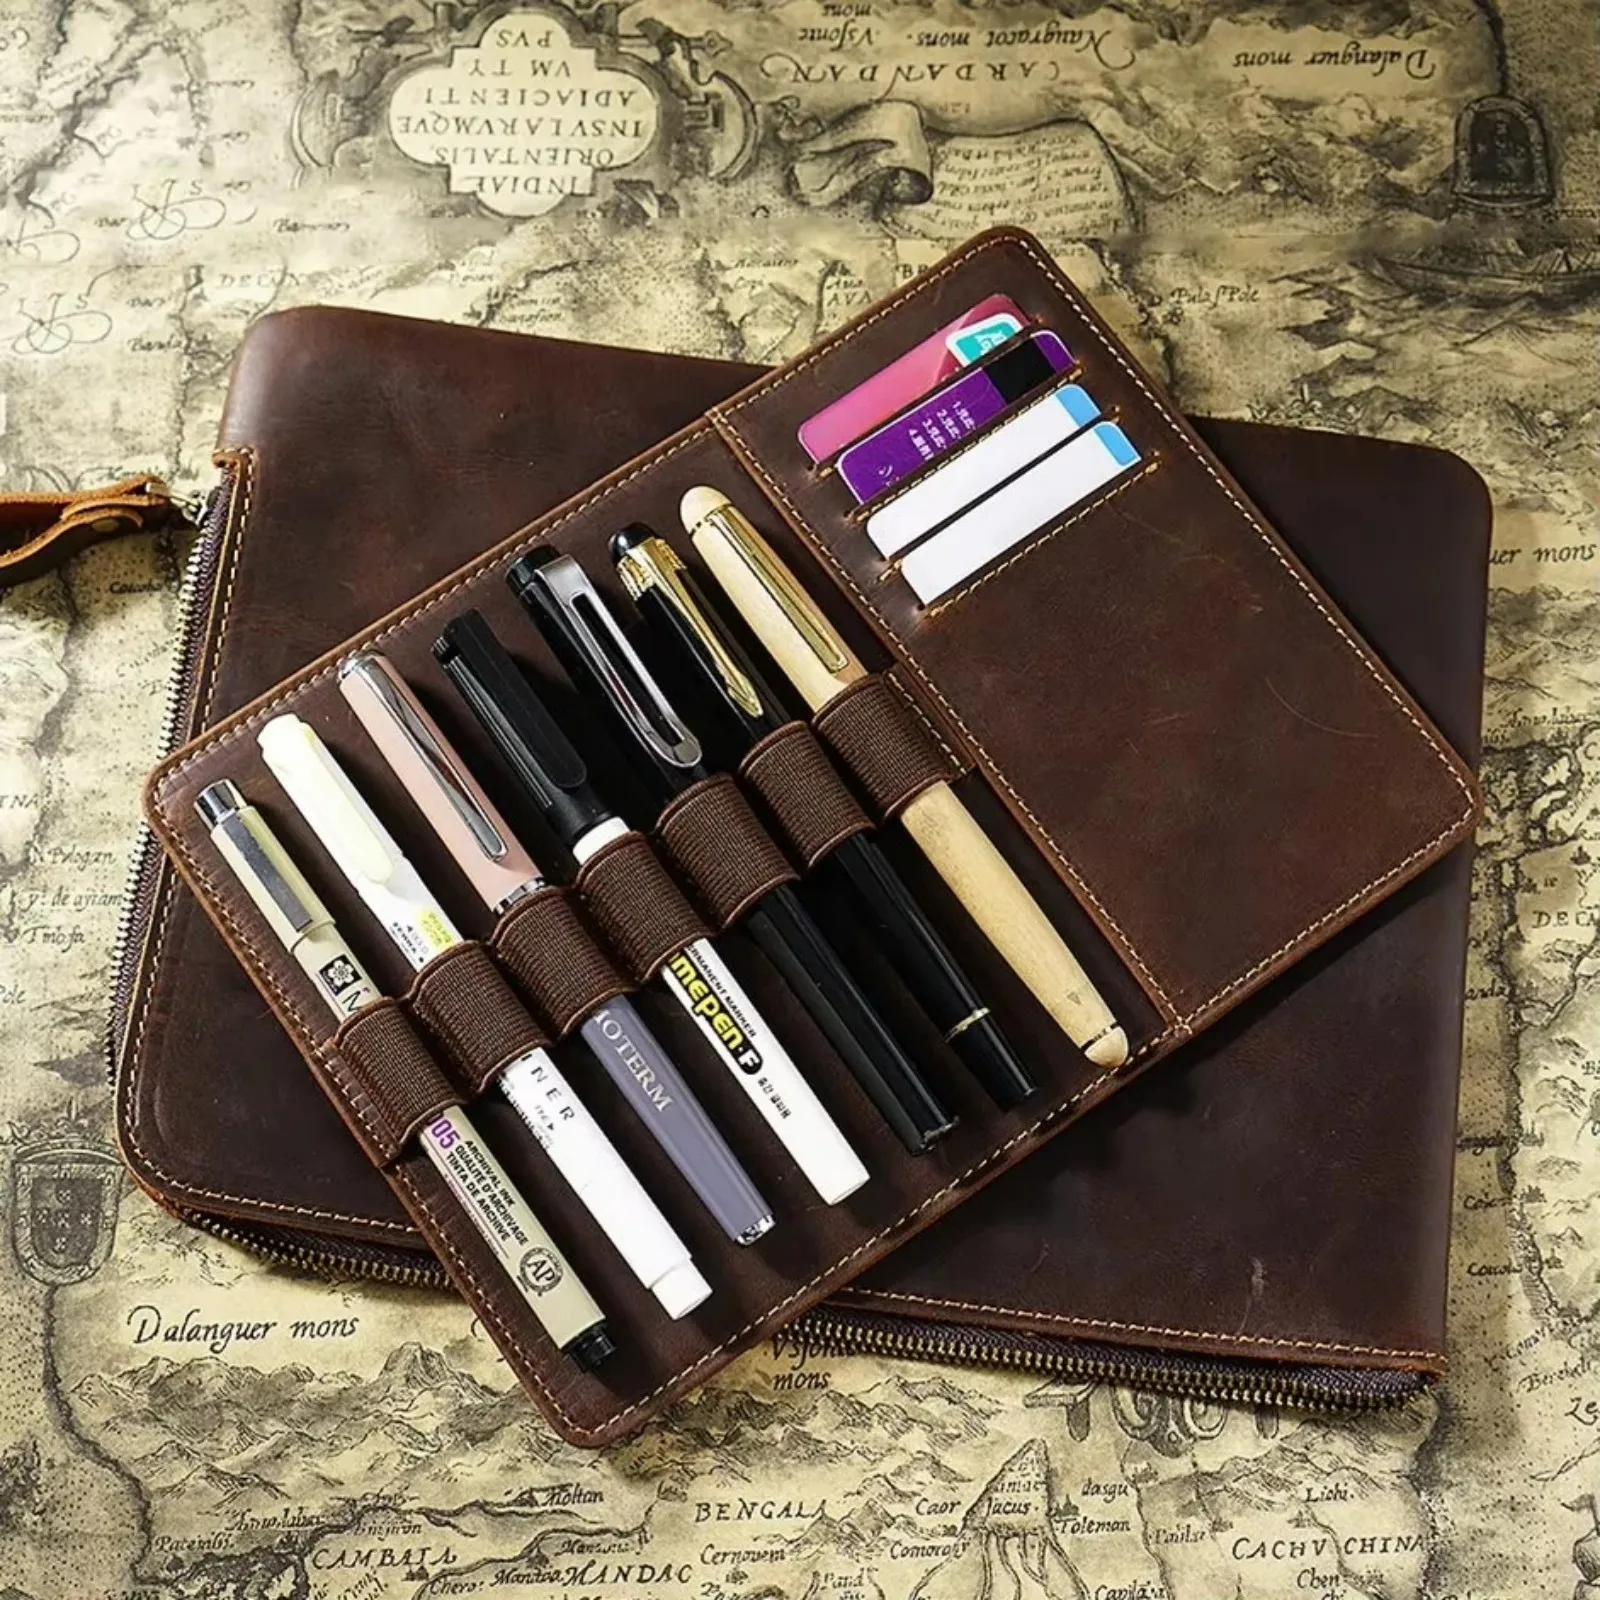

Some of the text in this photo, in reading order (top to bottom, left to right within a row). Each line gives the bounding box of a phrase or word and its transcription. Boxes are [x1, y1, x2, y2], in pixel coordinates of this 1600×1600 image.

[1233, 51, 1292, 68] mons
[1532, 541, 1598, 563] mons
[465, 1140, 501, 1189] ARCHIVAL
[446, 1151, 469, 1184] TINTA
[477, 1197, 511, 1242] ARCHIVE
[127, 1304, 360, 1354] Dalanguer mons
[773, 1371, 832, 1391] mons
